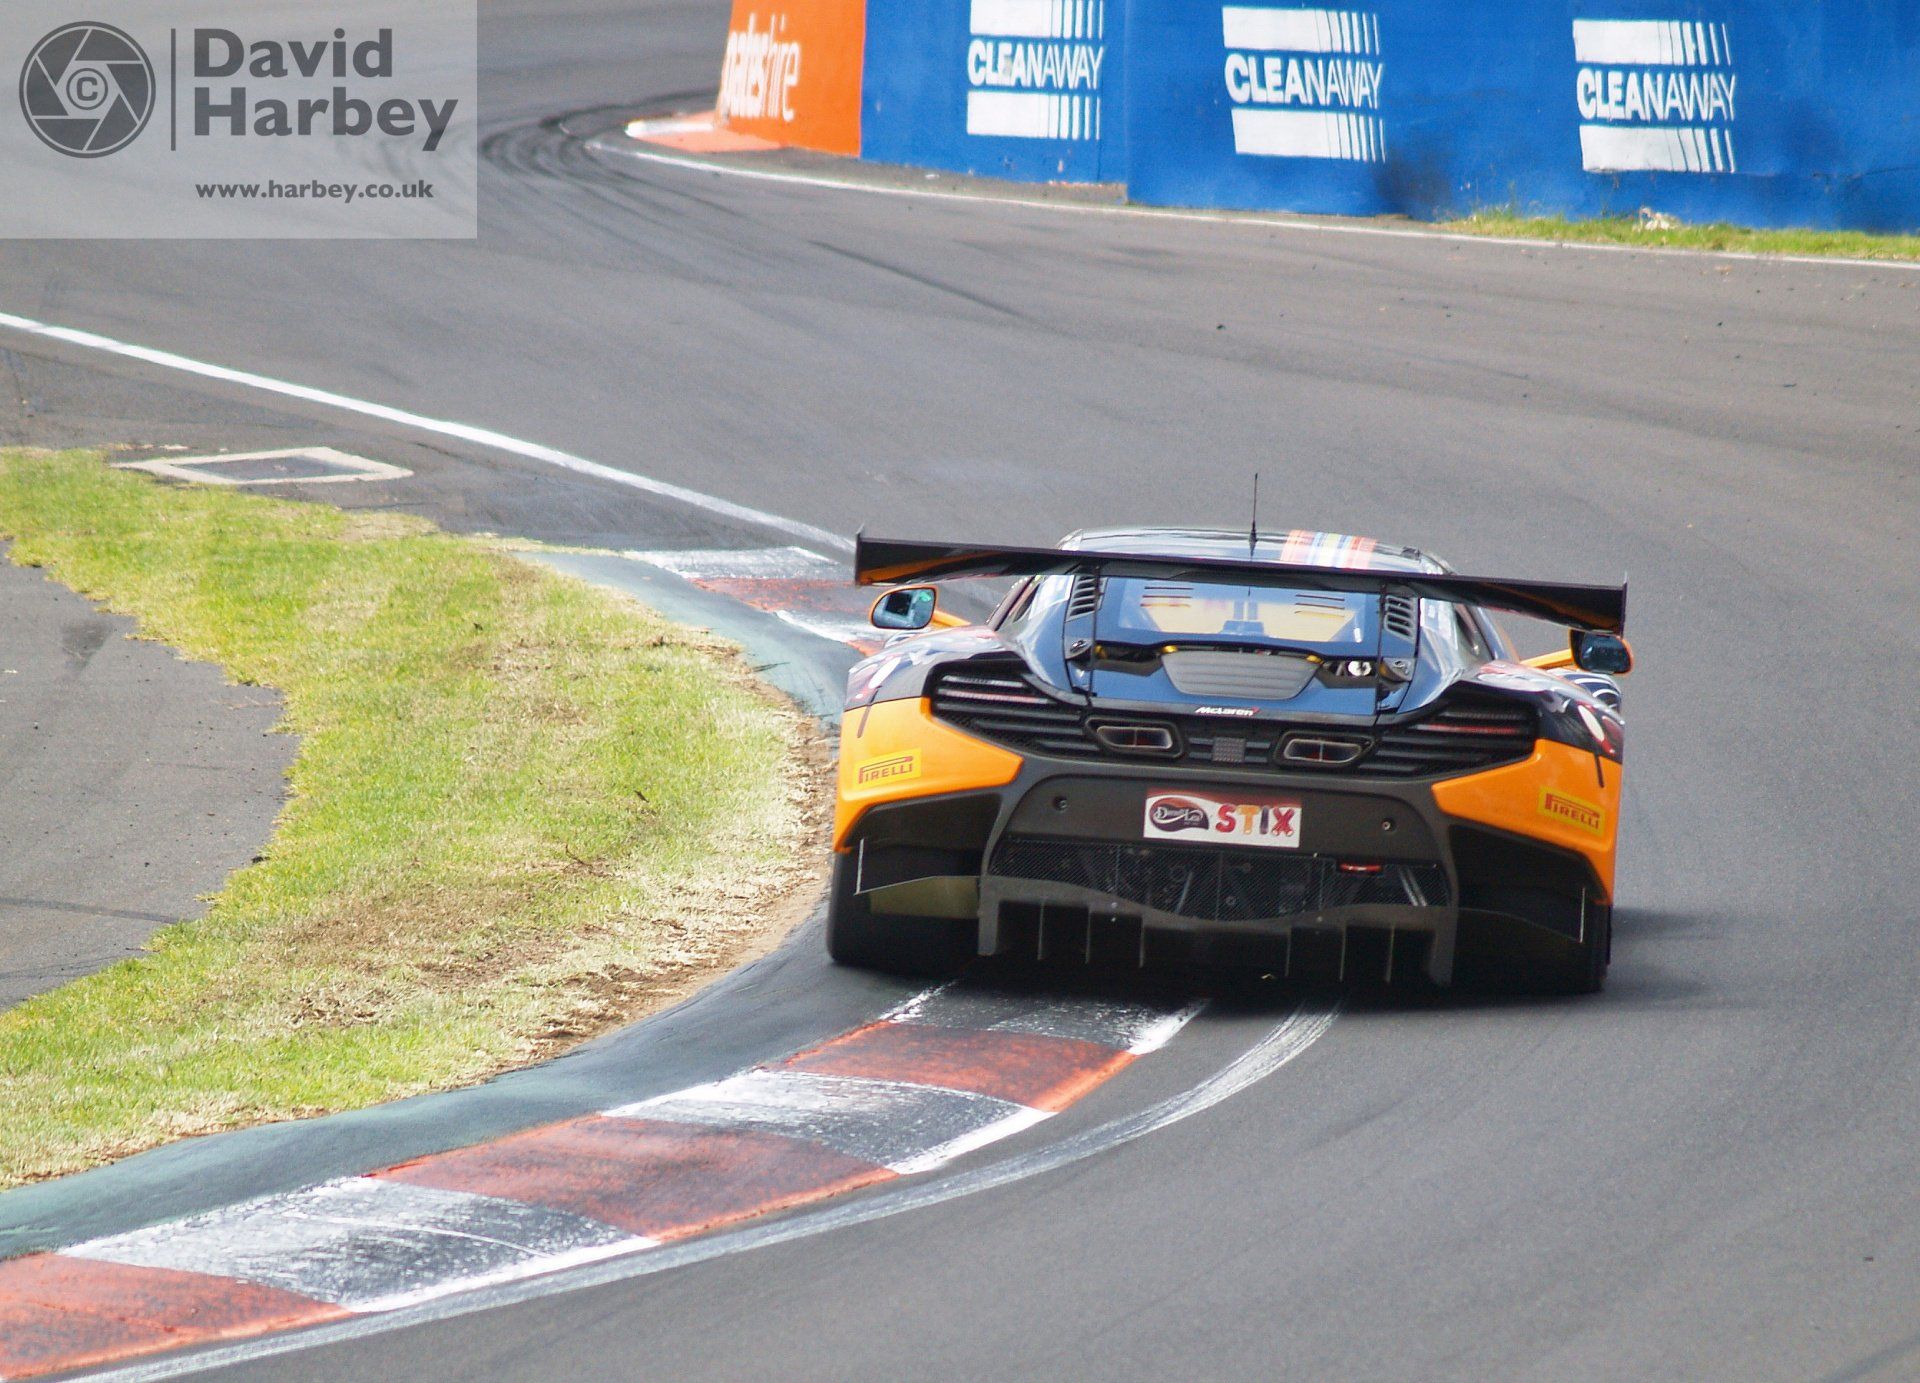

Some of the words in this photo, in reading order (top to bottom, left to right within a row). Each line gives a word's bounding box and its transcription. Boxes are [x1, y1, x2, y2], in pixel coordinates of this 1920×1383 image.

[968, 39, 1103, 90] CLEANAWAY
[1225, 53, 1382, 109] CLEANAWAY
[1577, 68, 1735, 121] CLEANAWAY
[858, 756, 914, 784] PIRELLI
[1215, 803, 1294, 836] STIX
[1545, 793, 1600, 829] PIRELLI
